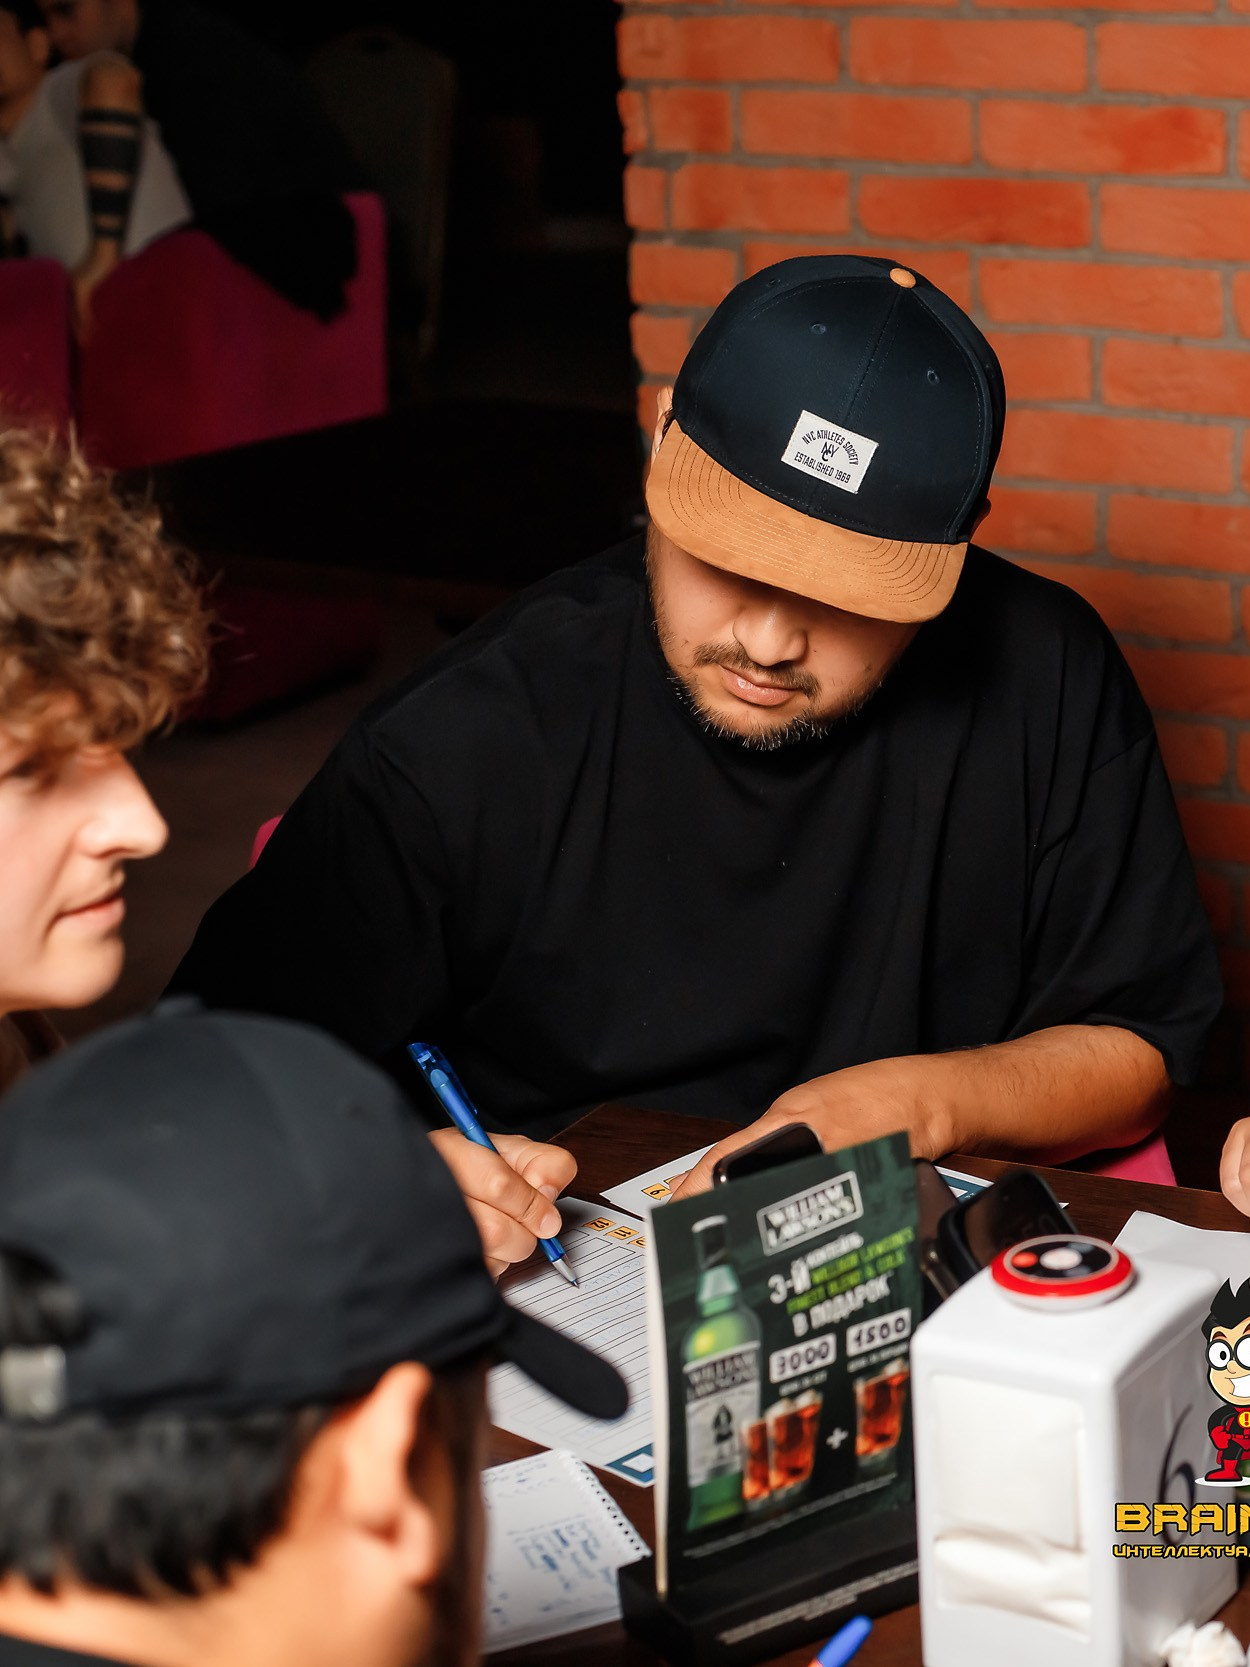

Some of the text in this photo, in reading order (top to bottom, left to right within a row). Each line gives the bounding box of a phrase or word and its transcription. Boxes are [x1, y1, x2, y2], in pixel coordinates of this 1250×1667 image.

[802, 429, 859, 465] NYC ATHLETES SOCIETY
[794, 451, 835, 477] ESTABLISHED
[592, 1220, 609, 1229] 12
[614, 1229, 631, 1237] 11
[854, 1317, 906, 1347] 1500
